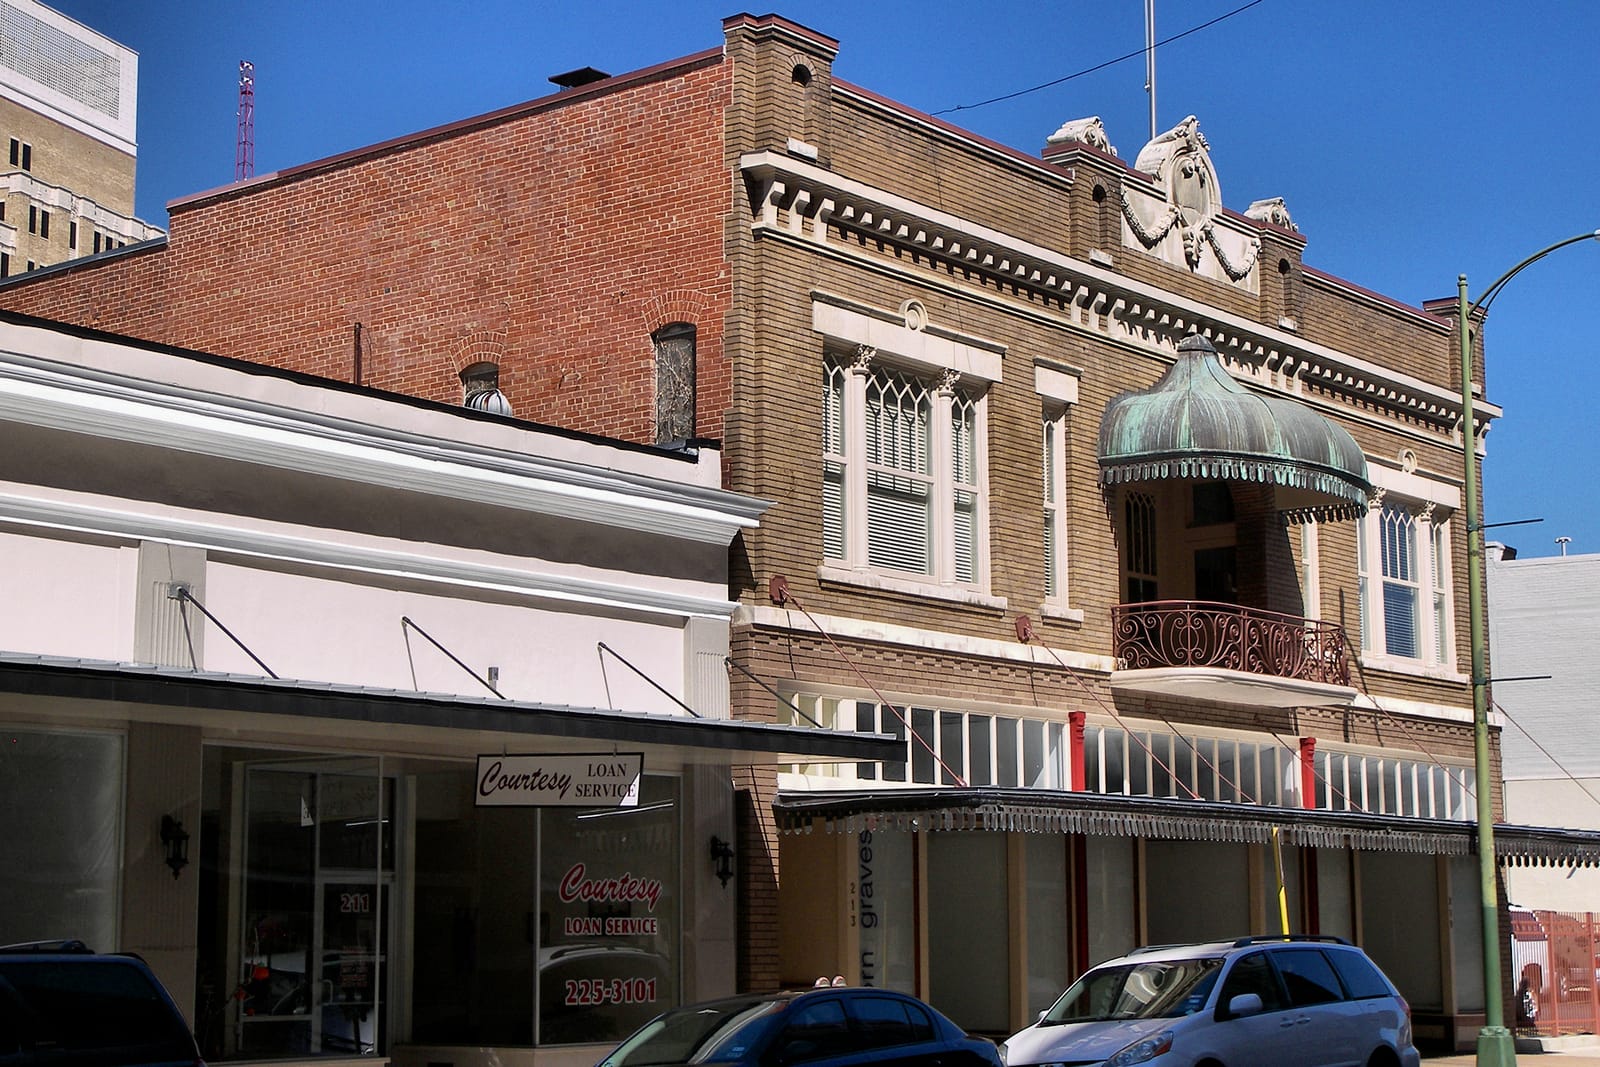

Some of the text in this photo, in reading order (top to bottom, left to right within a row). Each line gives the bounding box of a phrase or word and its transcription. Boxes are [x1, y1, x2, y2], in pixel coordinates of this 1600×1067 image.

[479, 761, 572, 800] Courtesy
[587, 763, 627, 778] LOAN
[575, 783, 636, 798] SERVICE
[559, 863, 662, 912] Courtesy
[859, 829, 878, 929] graves
[341, 893, 370, 913] 211
[565, 917, 657, 935] LOAN SERVICE
[565, 977, 657, 1005] 225-3101
